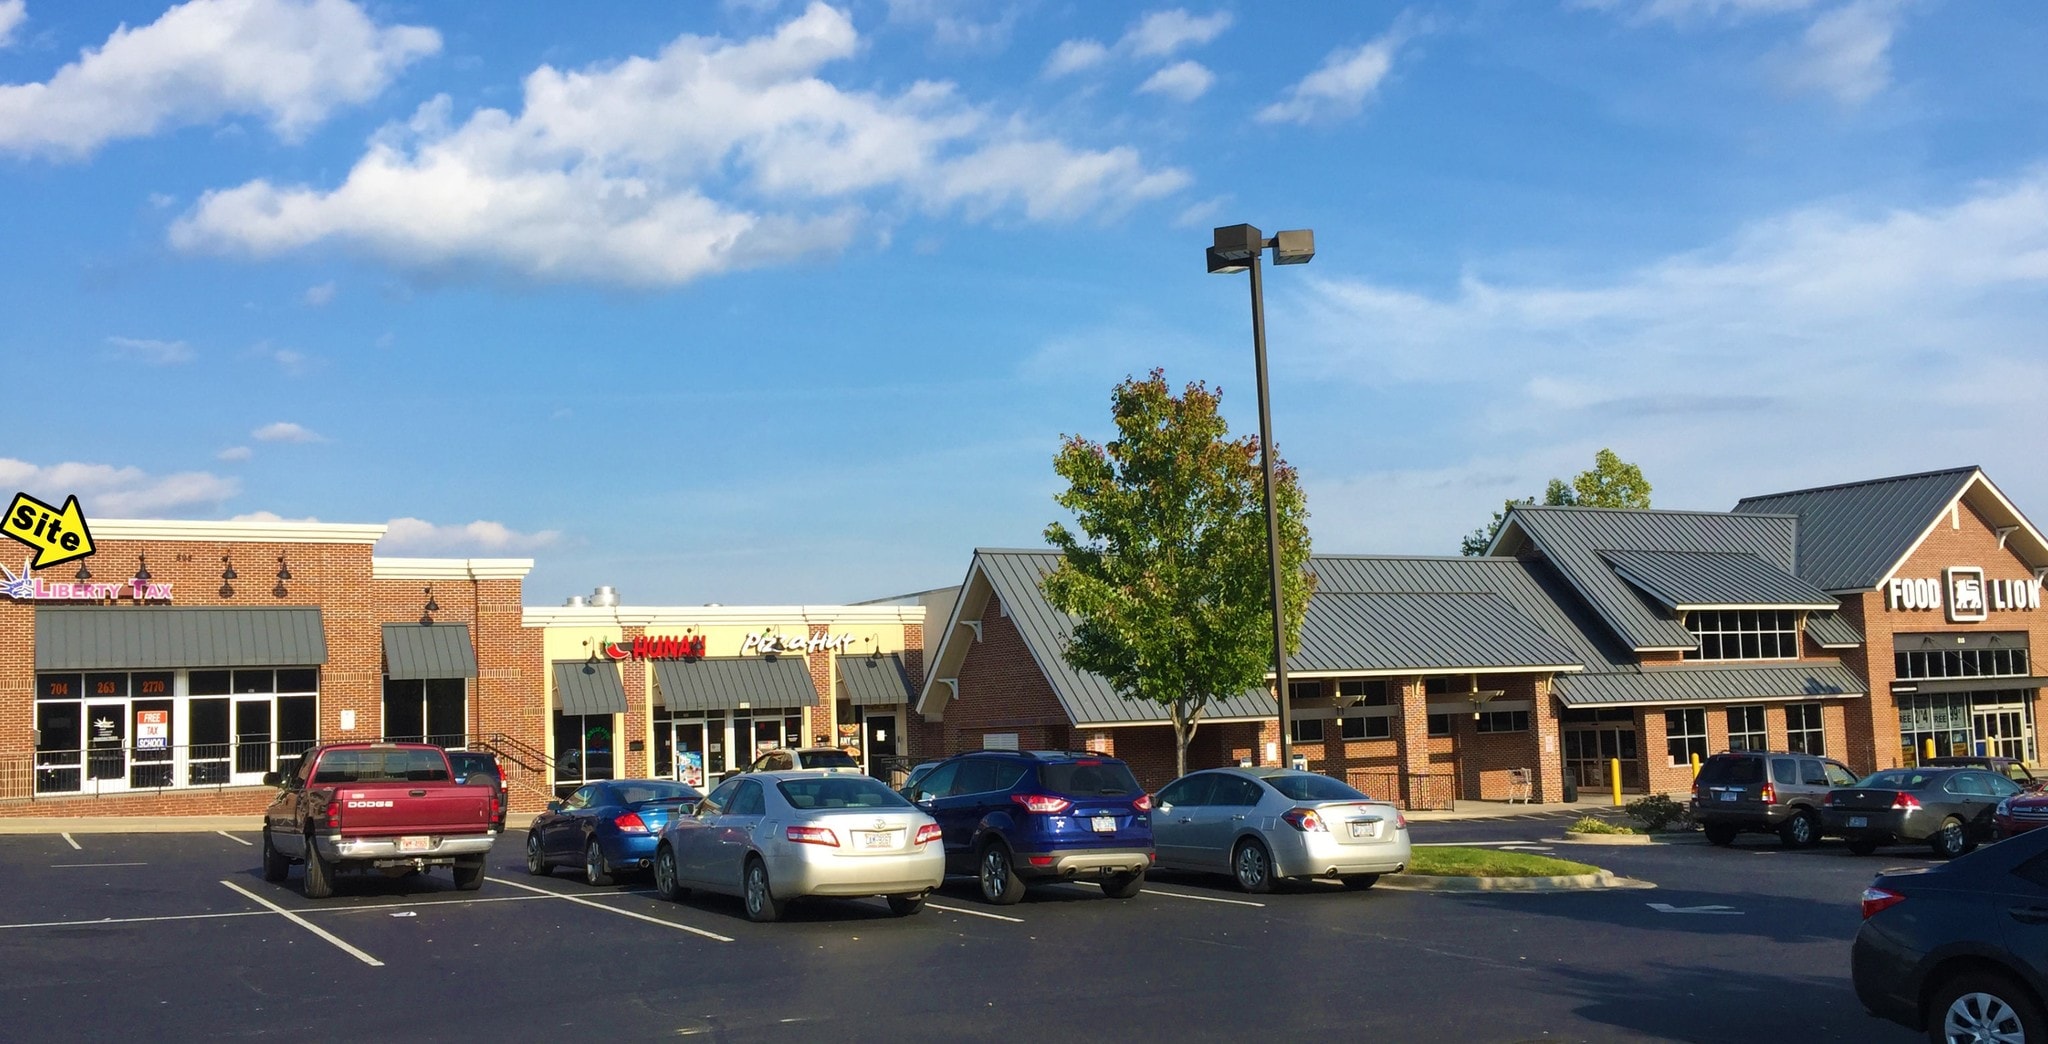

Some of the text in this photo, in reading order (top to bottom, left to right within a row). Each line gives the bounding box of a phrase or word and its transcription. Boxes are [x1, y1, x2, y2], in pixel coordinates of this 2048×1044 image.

[129, 578, 173, 599] TAX
[1889, 578, 2041, 609] FOOD LION
[50, 681, 165, 695] 704 263 2770
[143, 712, 161, 723] FREE
[147, 726, 159, 735] TAX
[139, 739, 166, 748] SCHOOL
